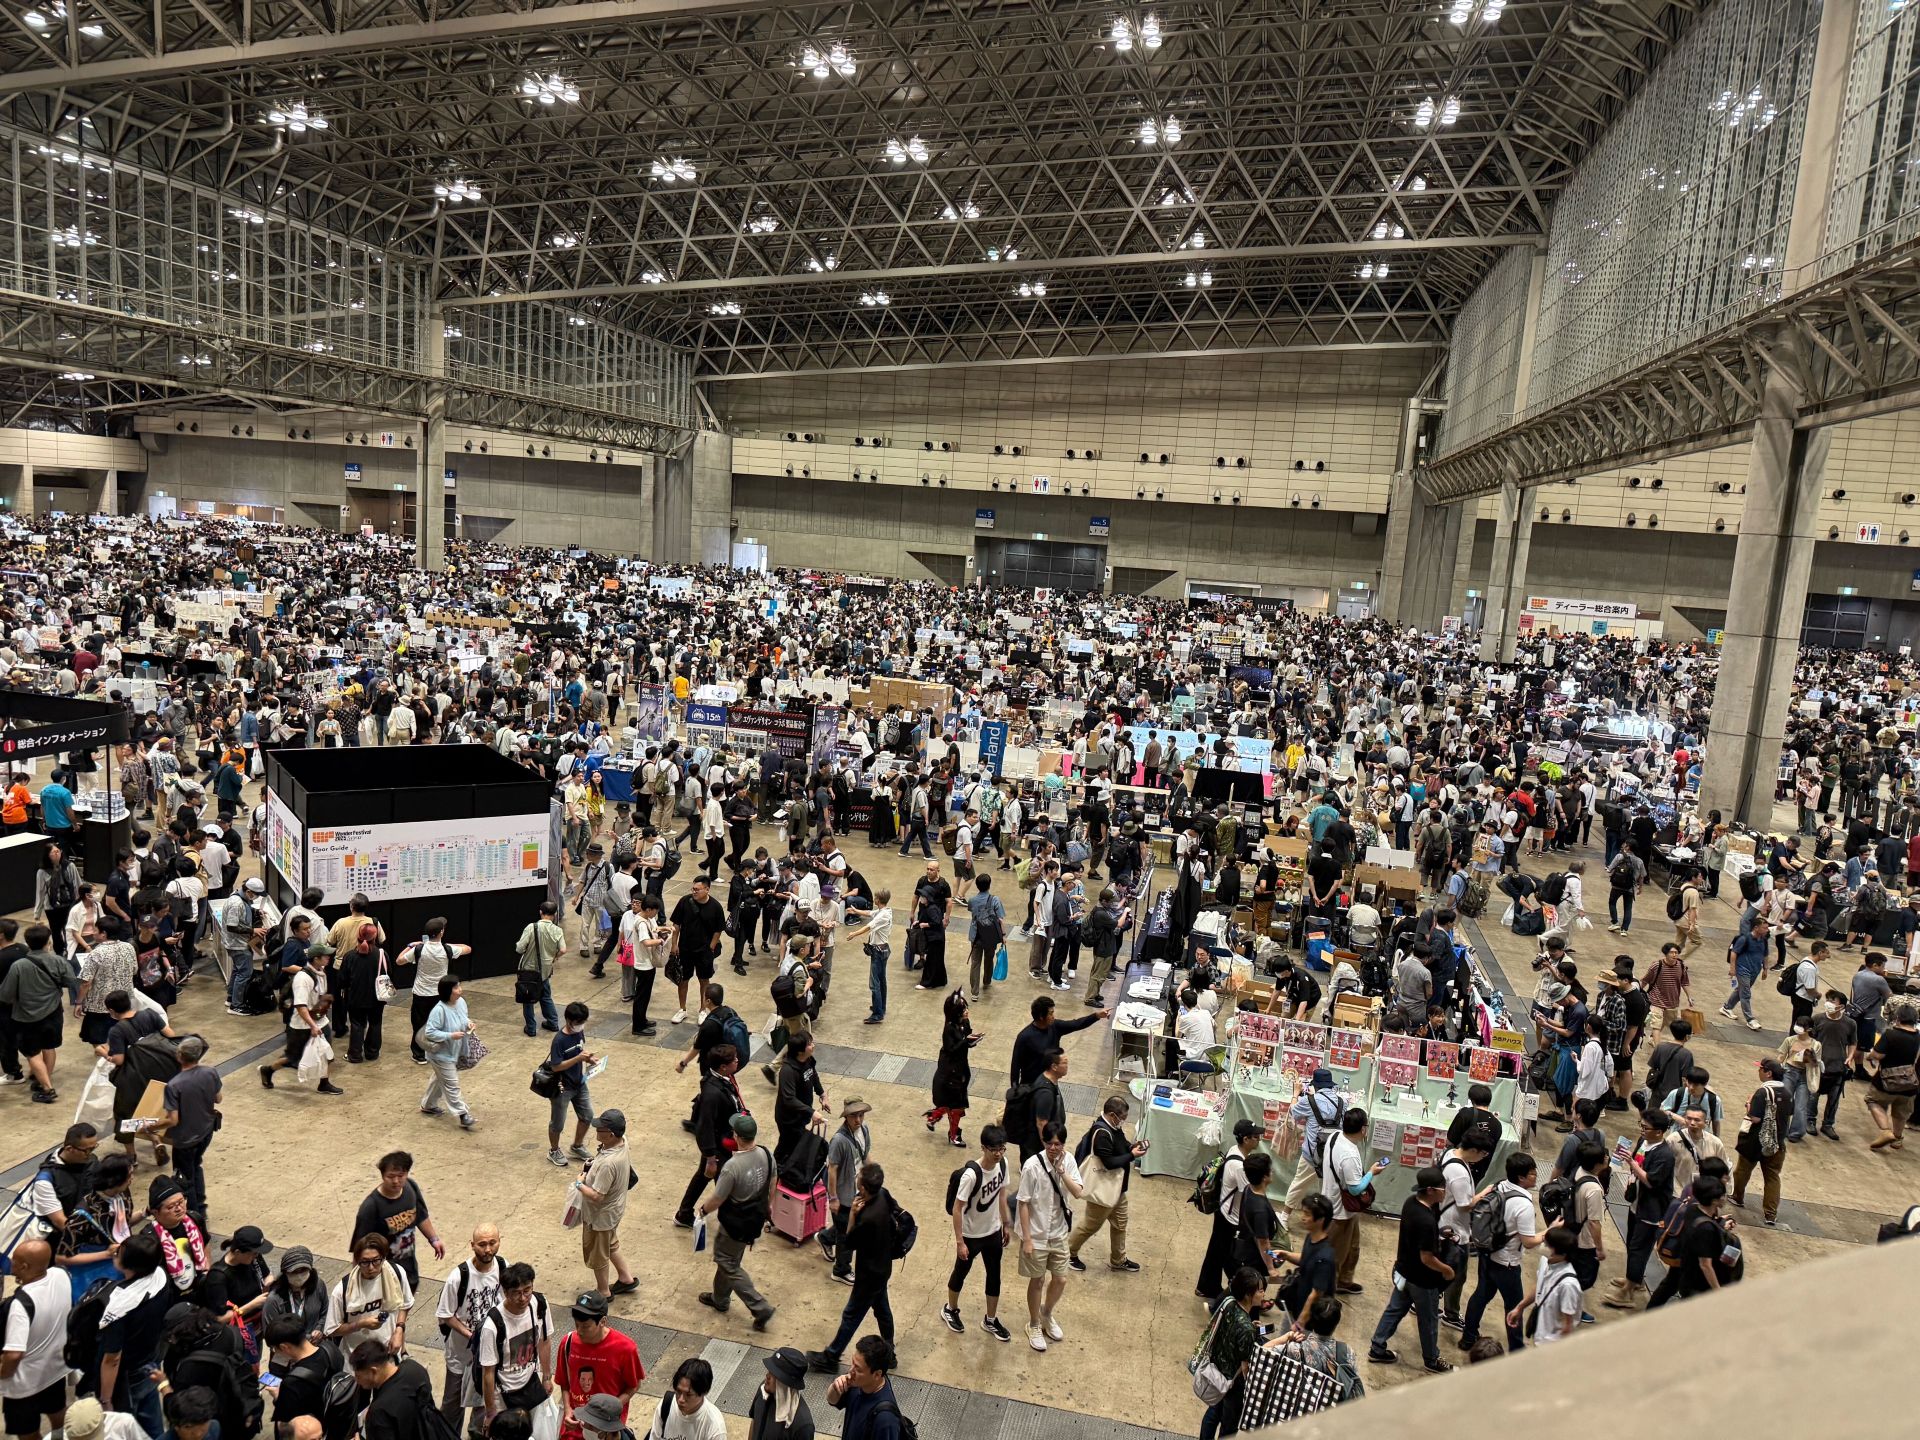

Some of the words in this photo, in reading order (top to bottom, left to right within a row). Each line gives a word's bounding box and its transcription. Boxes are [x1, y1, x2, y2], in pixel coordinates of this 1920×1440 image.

[1555, 601, 1629, 615] ディーラー総合案内
[706, 712, 721, 721] 15th
[742, 715, 772, 726] エヴァンゲリオン
[17, 727, 107, 750] 総合インフォメーション
[847, 812, 870, 822] ンゲリオン
[330, 844, 348, 852] Guide
[981, 1171, 1005, 1199] FREA
